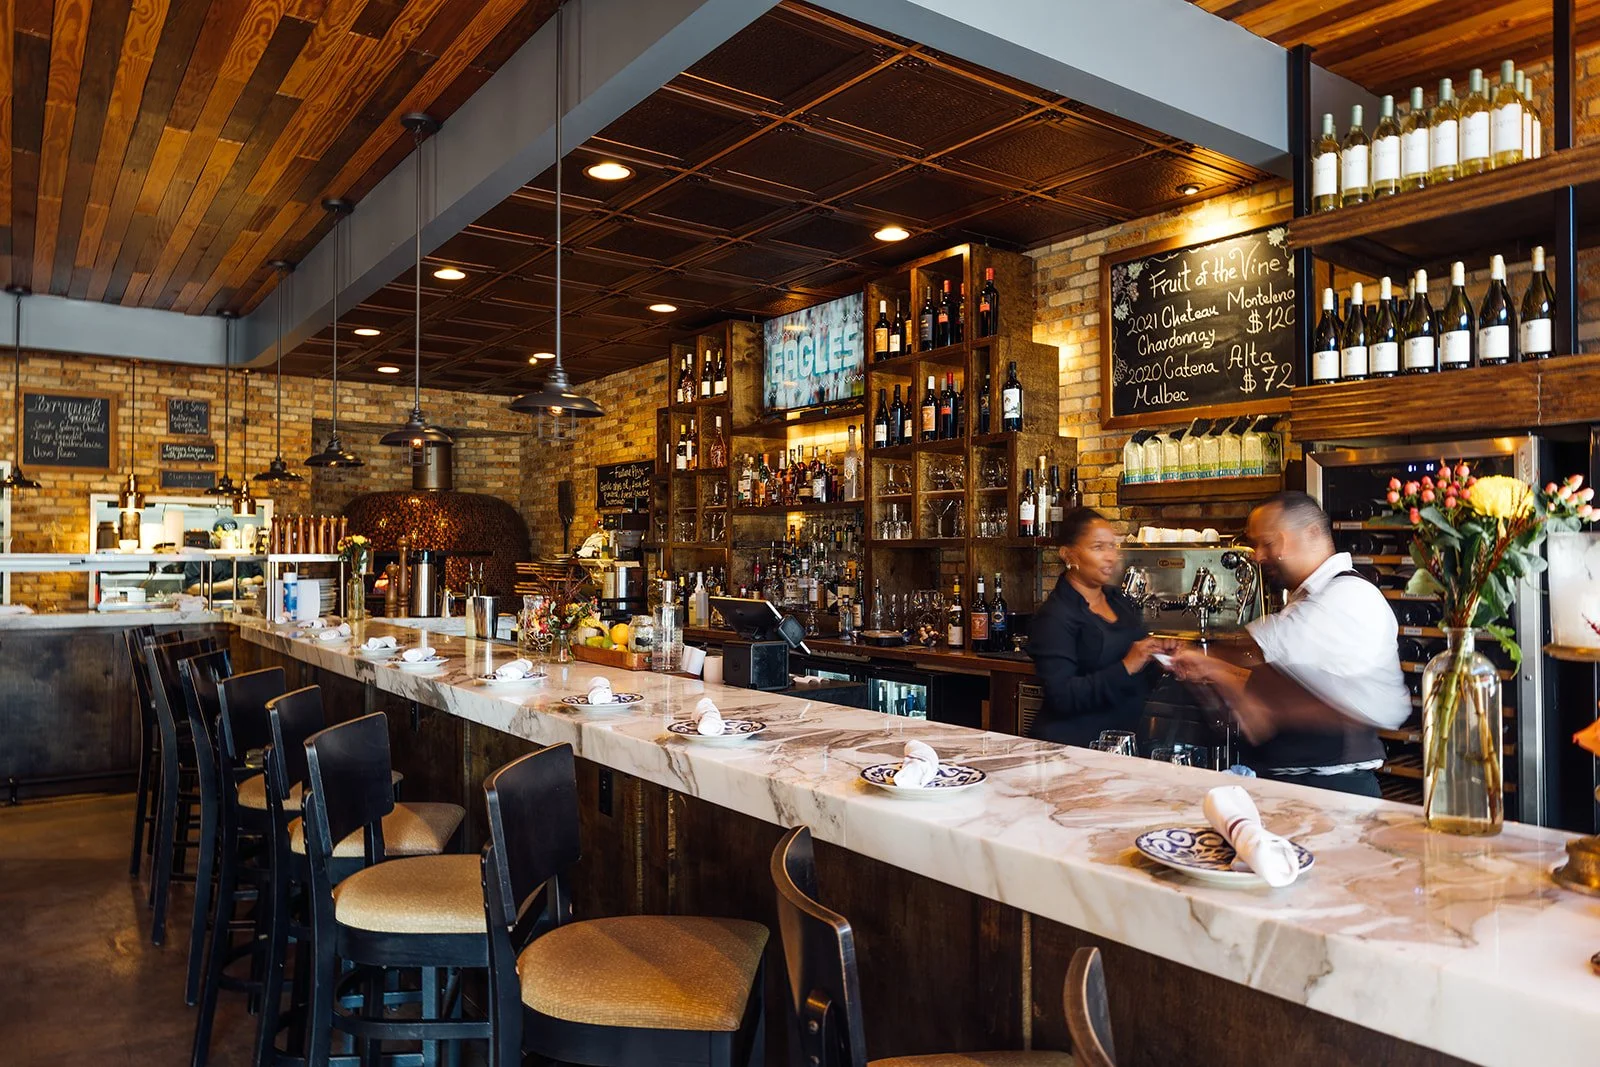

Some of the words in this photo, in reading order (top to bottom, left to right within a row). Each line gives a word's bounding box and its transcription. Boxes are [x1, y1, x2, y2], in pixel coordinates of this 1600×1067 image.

[1149, 260, 1191, 298] Fruit
[1195, 260, 1209, 286] of
[1213, 259, 1237, 282] the
[1229, 242, 1281, 281] Vine
[1127, 313, 1158, 336] 2021
[1162, 299, 1219, 329] Chateau
[771, 323, 858, 384] EAGLES
[1137, 329, 1216, 356] Chardonnay
[1126, 363, 1162, 385] 2020
[1164, 354, 1219, 379] Catena
[1227, 341, 1275, 370] Alta
[34, 395, 102, 416] Brunch
[1133, 382, 1189, 408] Malbec
